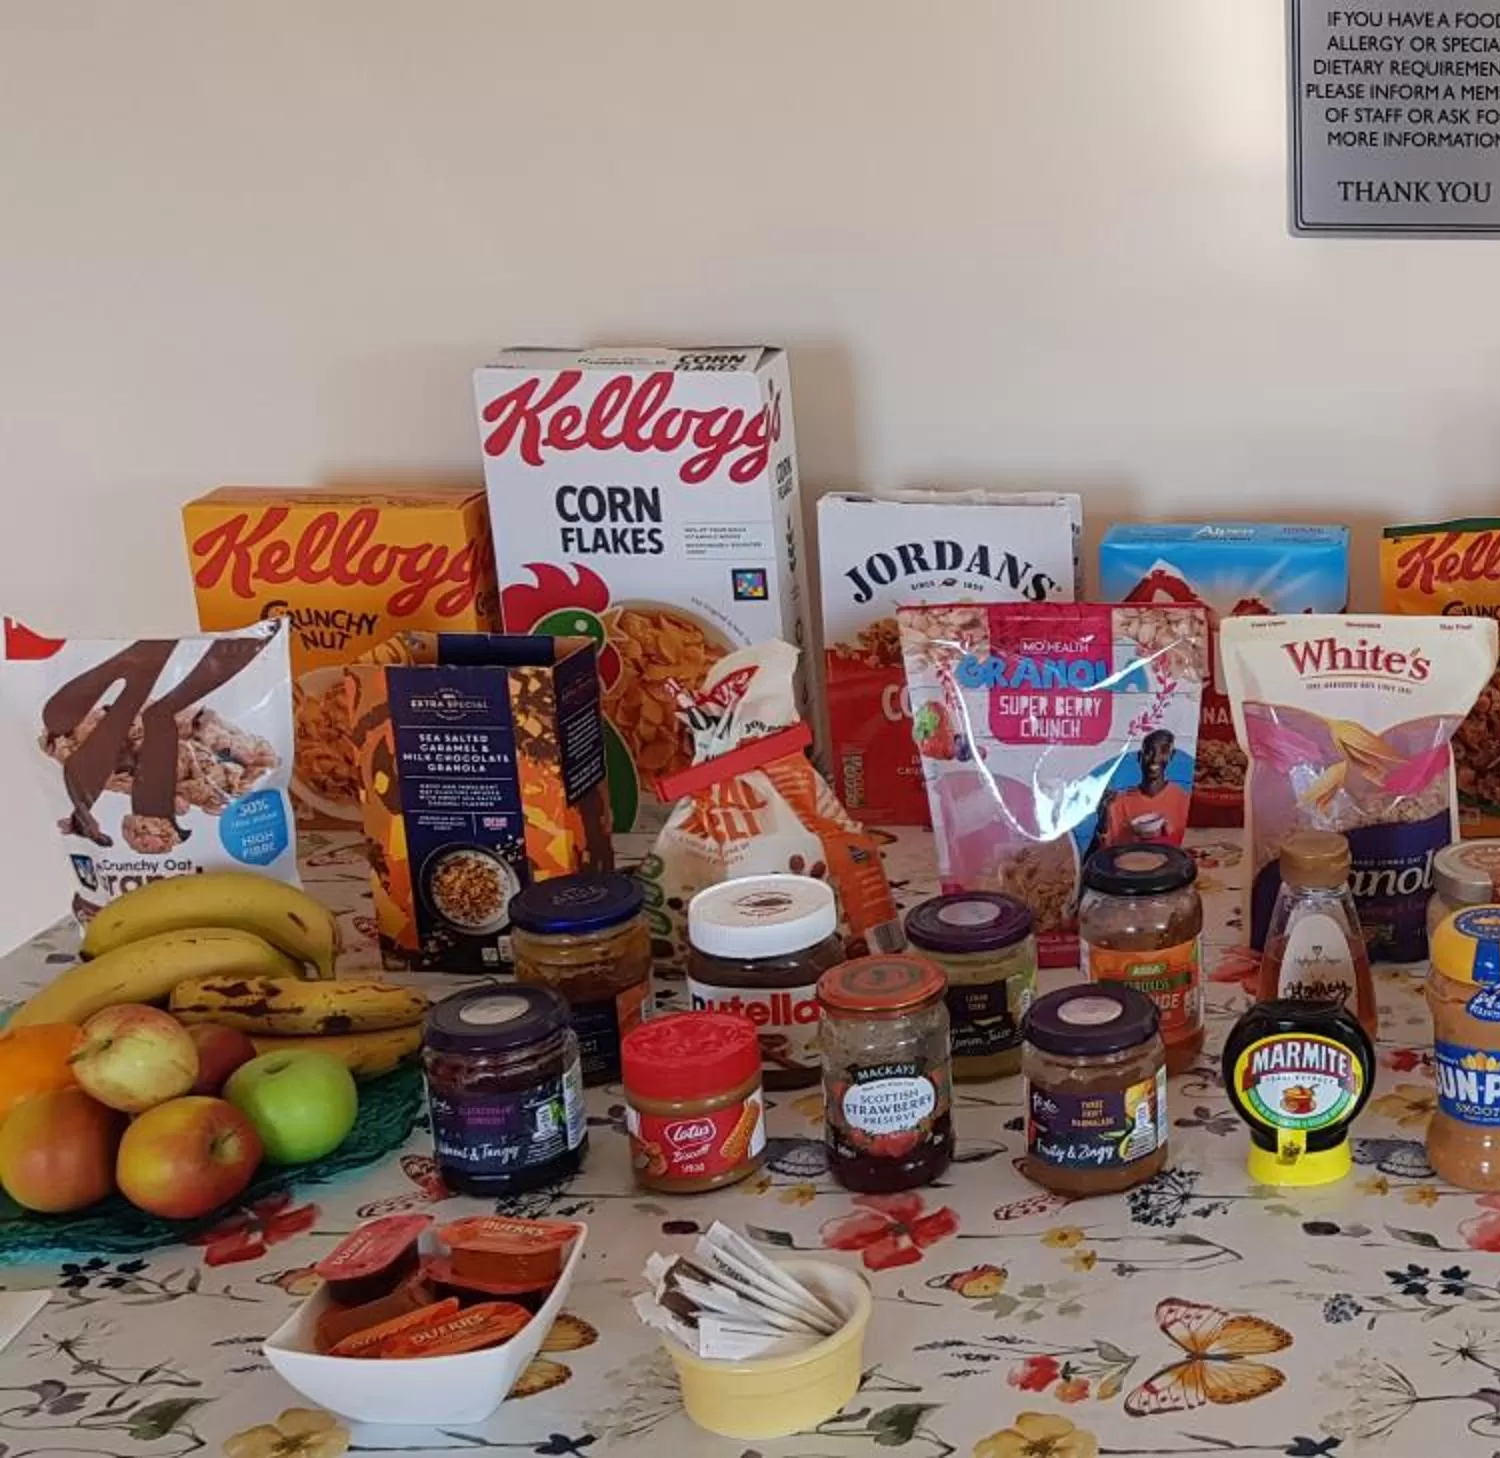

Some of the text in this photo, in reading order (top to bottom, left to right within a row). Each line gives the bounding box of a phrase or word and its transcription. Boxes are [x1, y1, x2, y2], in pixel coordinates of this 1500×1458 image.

[1327, 12, 1341, 27] IF
[1342, 12, 1382, 28] YOU
[1388, 12, 1434, 28] HAVE
[1437, 13, 1450, 27] A
[1327, 36, 1404, 52] ALLERGY
[1410, 37, 1436, 52] OR
[1313, 60, 1384, 75] DIETARY
[1306, 84, 1364, 99] PLEASE
[1370, 84, 1439, 100] INFORM
[1443, 85, 1455, 100] A
[1325, 108, 1349, 123] OF
[1354, 108, 1402, 123] STAFF
[1407, 109, 1433, 124] OR
[1438, 109, 1470, 124] ASK
[1328, 132, 1378, 147] MORE
[1338, 181, 1492, 203] THANK YOU
[678, 354, 747, 364] CORN
[555, 485, 663, 523] CORN
[560, 527, 665, 555] FLAKES
[844, 539, 1056, 604] JORDANS
[301, 632, 352, 651] NUT
[1280, 637, 1432, 682] White's
[955, 654, 1149, 693] GRANOLA
[1000, 694, 1103, 718] SUPER BERRY
[1020, 718, 1081, 738] CRUNCH
[419, 734, 489, 744] SEA SALTED
[419, 743, 478, 753] CARAMEL
[402, 752, 511, 764] MILK CHOCOLATE
[427, 762, 487, 774] GRANOLA
[101, 859, 192, 874] Crunchy Oat
[1252, 1039, 1350, 1077] MARMITE
[844, 1093, 935, 1117] STRAWBERRY
[860, 1088, 920, 1105] SCOTTISH
[862, 1111, 917, 1126] PRESERVE
[673, 1122, 710, 1142] Lotus
[672, 1143, 711, 1163] Biscoff
